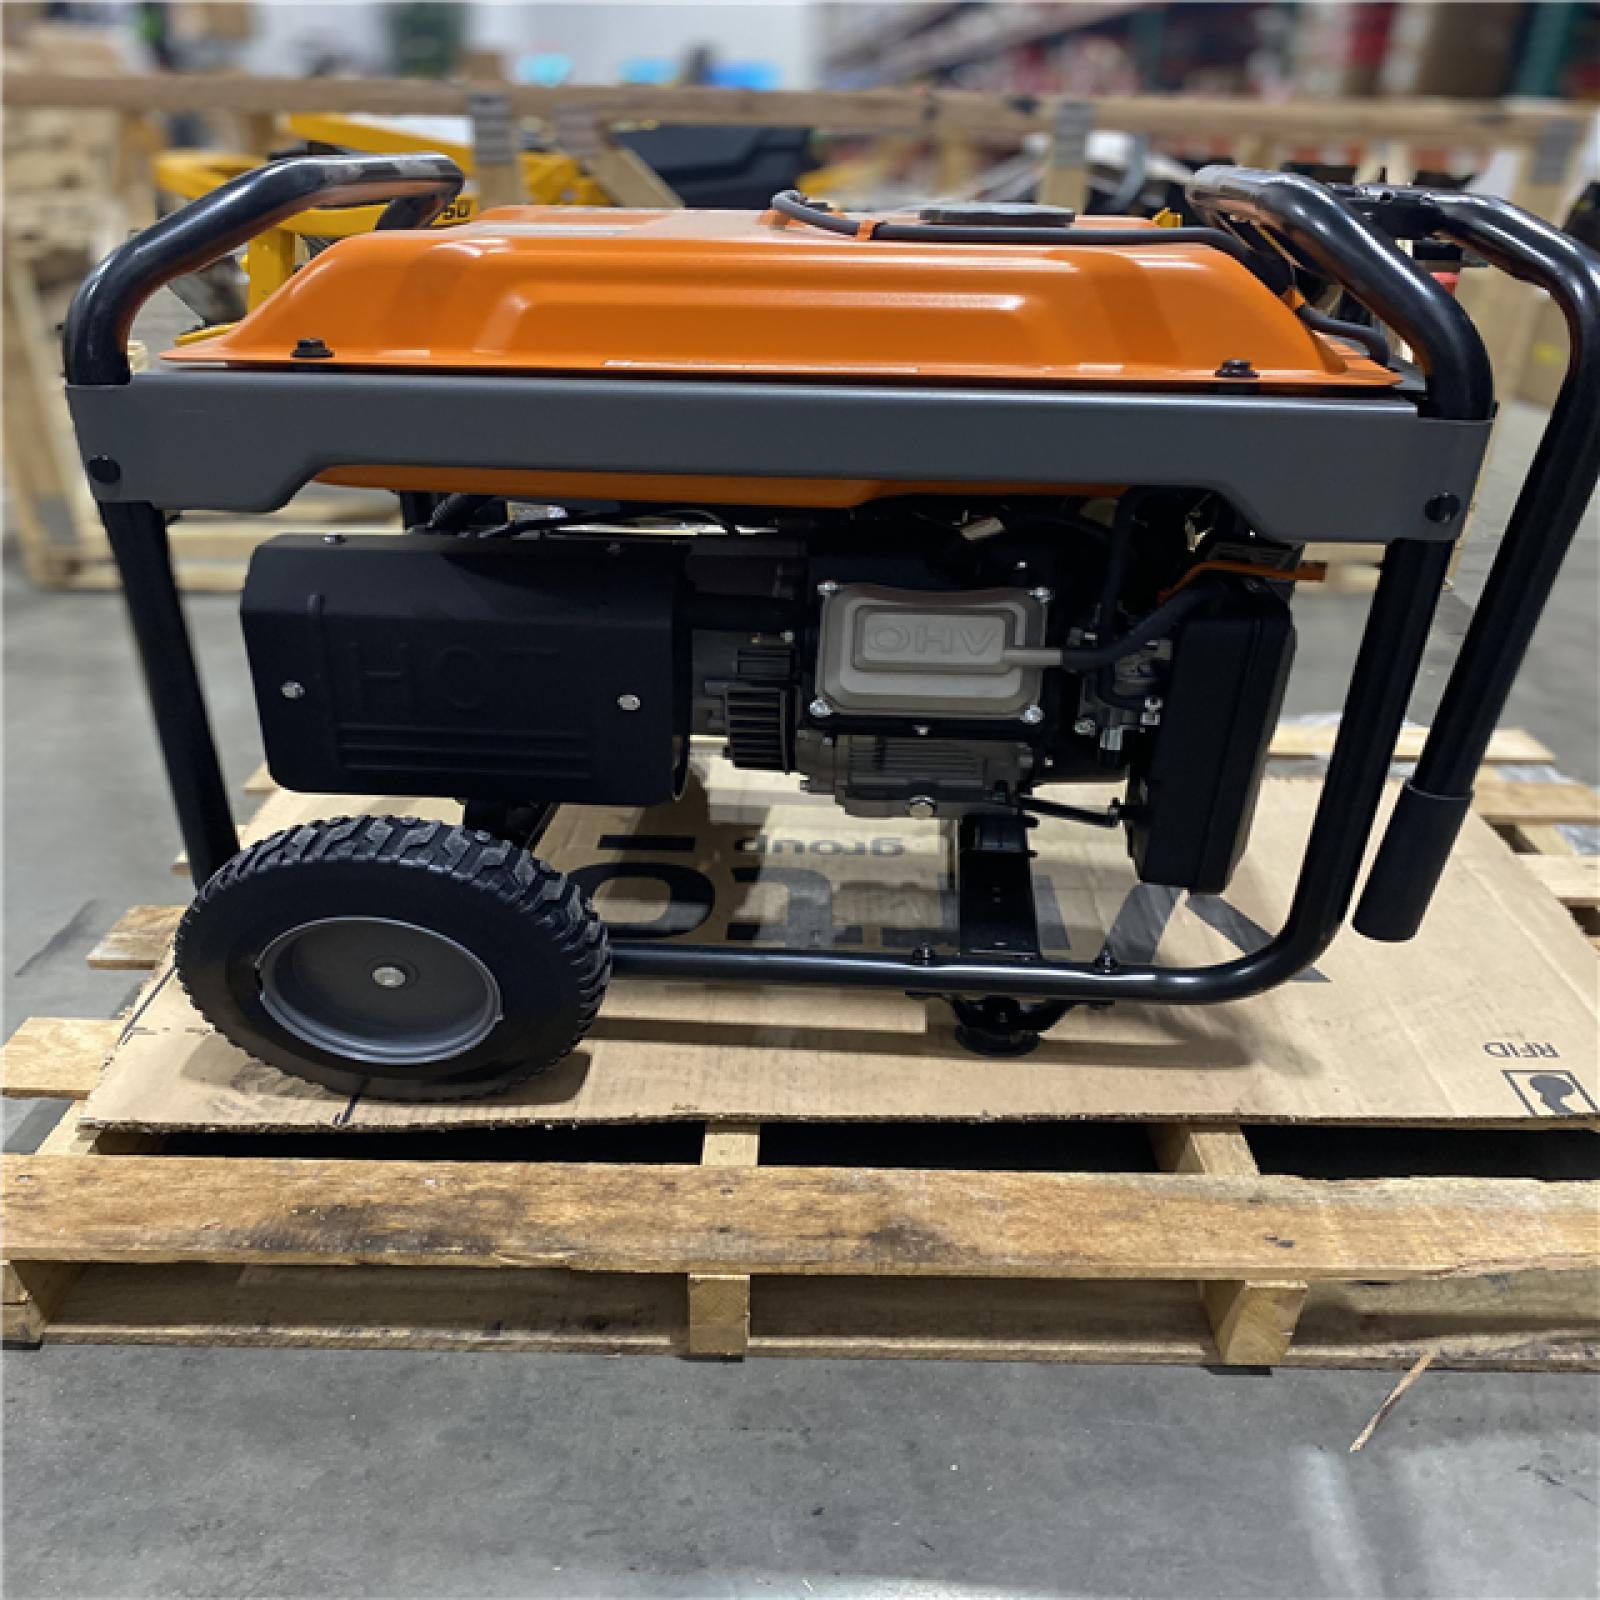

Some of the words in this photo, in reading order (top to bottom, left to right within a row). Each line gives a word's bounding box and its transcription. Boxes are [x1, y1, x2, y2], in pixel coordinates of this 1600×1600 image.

[866, 624, 998, 656] OHV
[346, 639, 562, 710] HOT
[734, 834, 905, 858] group
[1482, 1041, 1560, 1057] RFID
